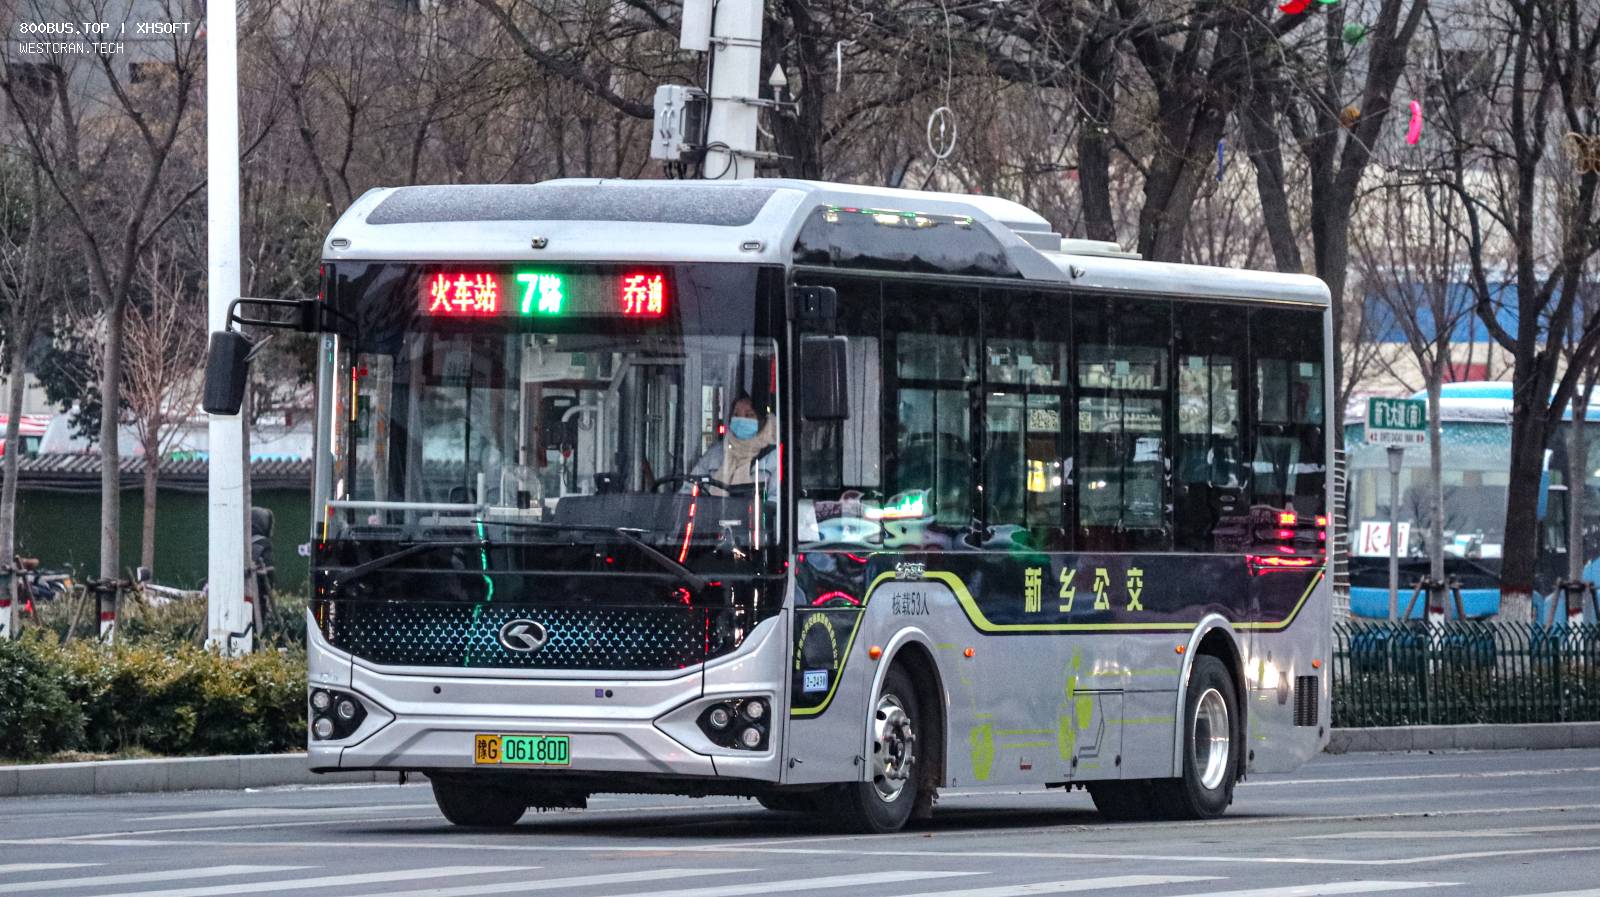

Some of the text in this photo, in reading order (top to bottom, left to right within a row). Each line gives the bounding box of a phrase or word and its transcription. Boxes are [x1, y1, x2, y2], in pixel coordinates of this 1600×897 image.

[429, 273, 497, 313] 火车站
[516, 273, 563, 314] 7路
[891, 591, 930, 617] 核载53人
[1024, 566, 1144, 613] 新乡公交
